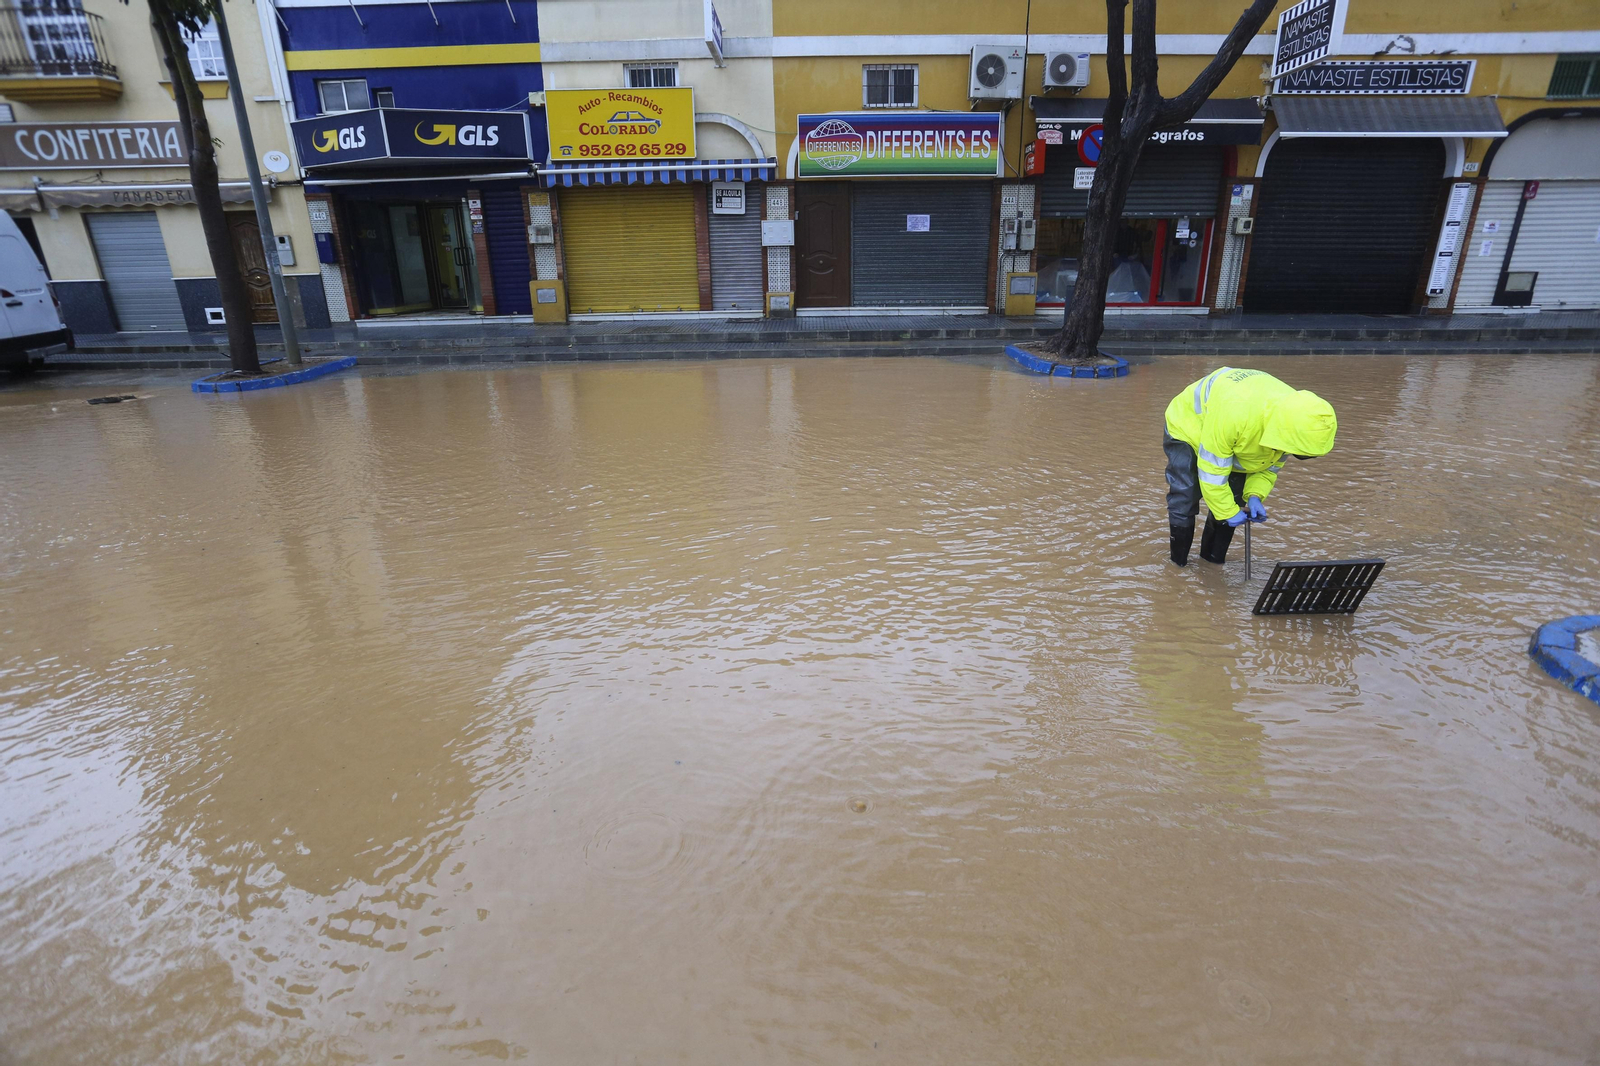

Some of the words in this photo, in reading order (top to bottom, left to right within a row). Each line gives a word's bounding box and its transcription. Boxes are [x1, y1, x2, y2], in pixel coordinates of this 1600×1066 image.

[1284, 5, 1330, 41] NAMASTE
[1277, 25, 1330, 61] ESTILISTAS
[1285, 69, 1365, 87] NAMASTE
[1369, 68, 1464, 87] ESTILISTAS
[578, 97, 601, 115] Auto
[608, 92, 664, 115] Recambios
[338, 125, 366, 150] GLS
[458, 125, 499, 146] GLS
[578, 123, 658, 136] COLORADO
[14, 127, 183, 161] CONFITERIA
[578, 144, 612, 157] 952
[614, 144, 637, 156] 62
[639, 143, 662, 156] 65
[664, 143, 687, 155] 29
[808, 141, 861, 153] DIFFERENTS.ES
[866, 130, 992, 159] DIFFERENTS.ES
[113, 190, 192, 203] PANADERI
[723, 189, 742, 197] ALQUILA
